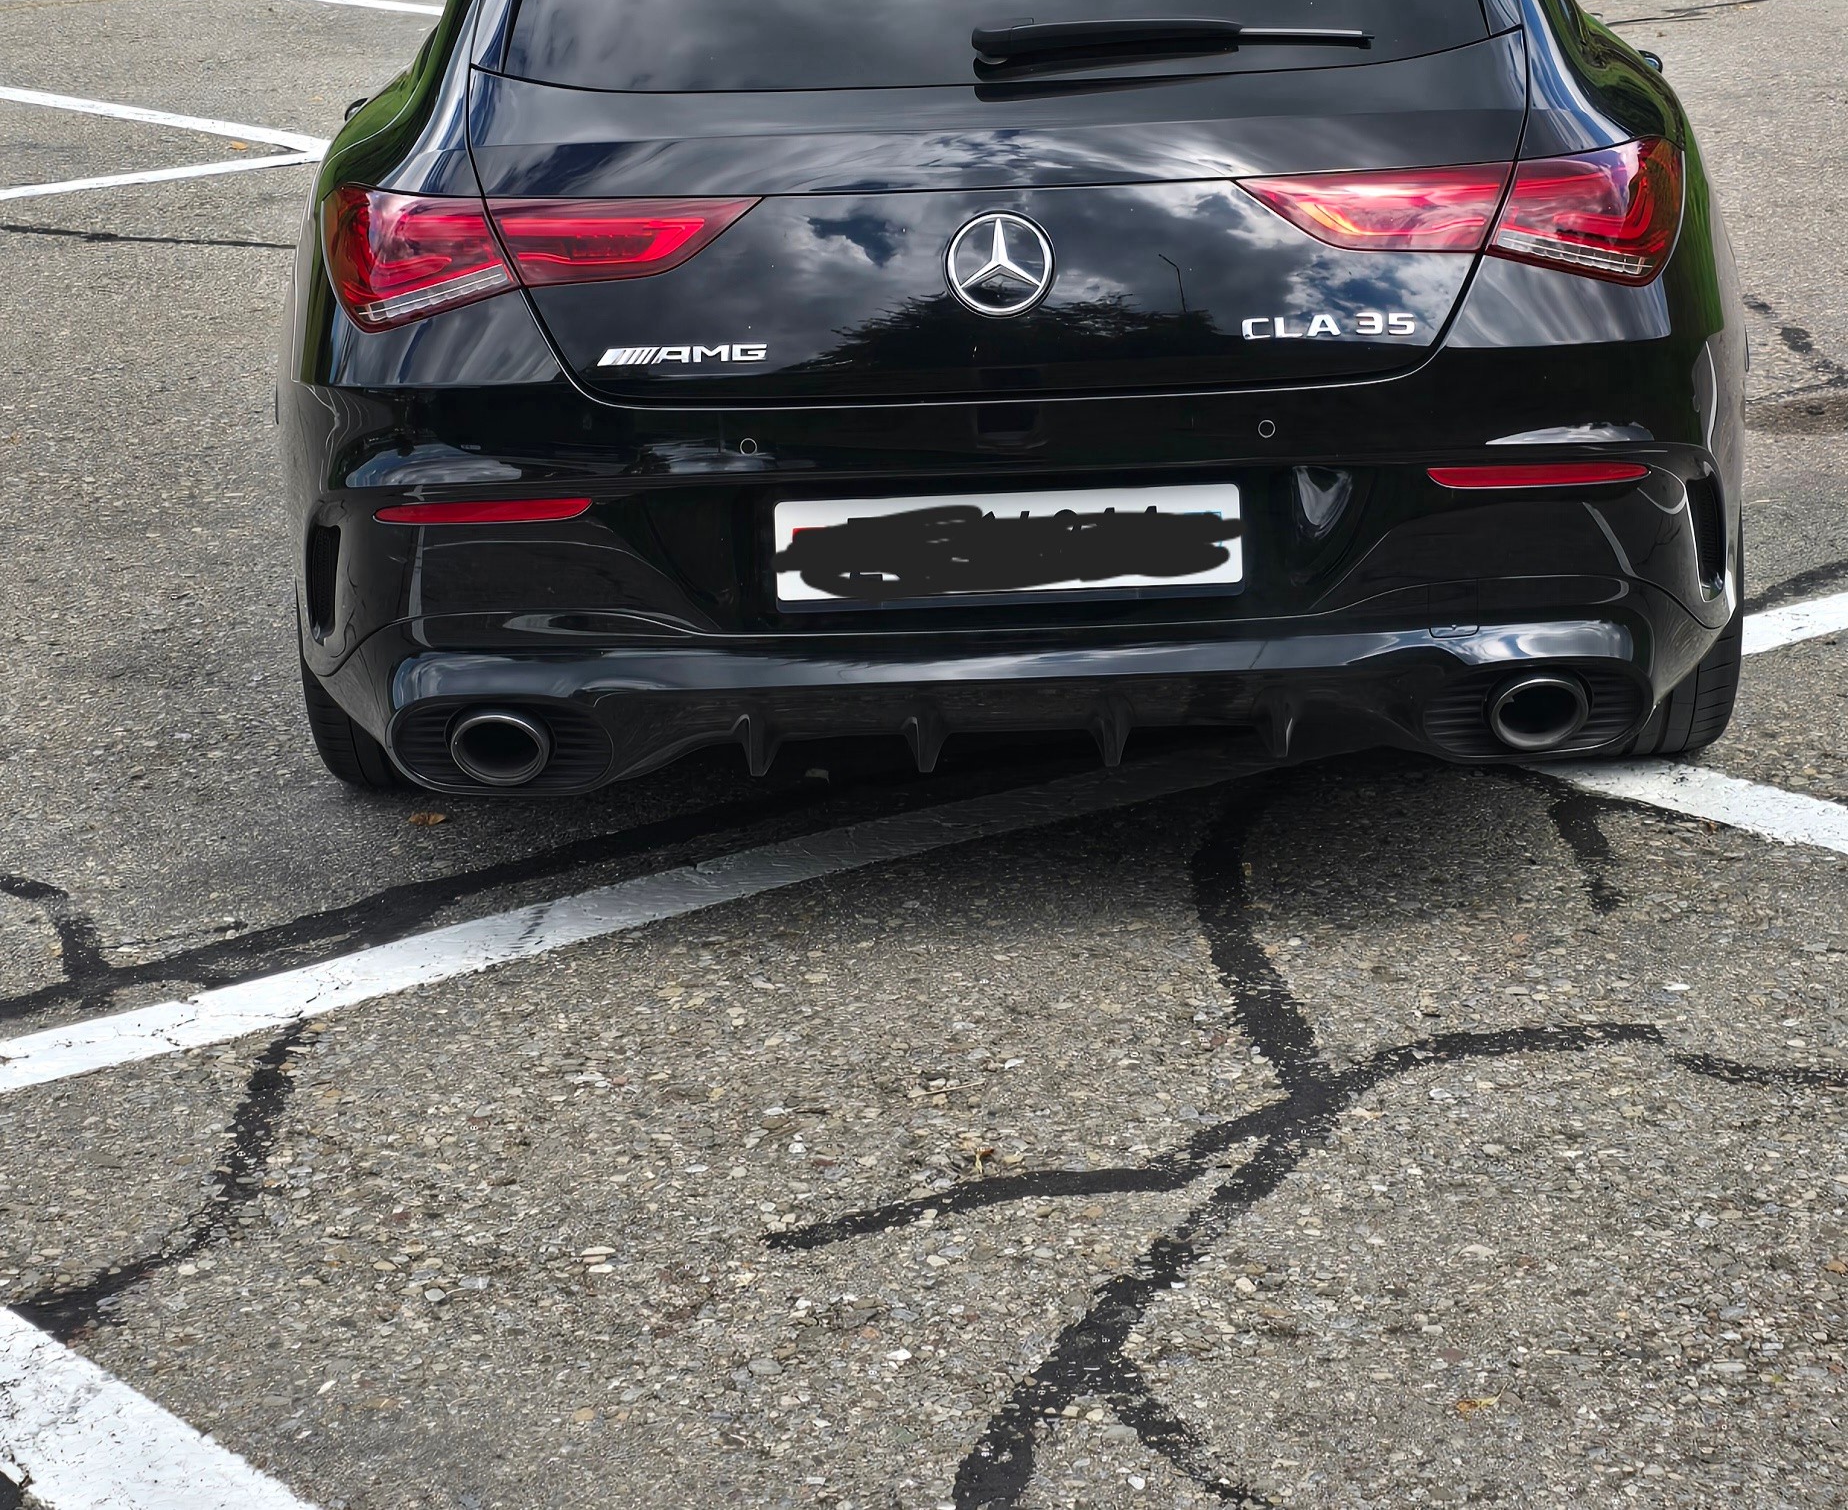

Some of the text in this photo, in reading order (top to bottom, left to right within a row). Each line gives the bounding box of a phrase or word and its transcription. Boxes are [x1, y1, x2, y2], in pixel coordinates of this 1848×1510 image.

[1241, 312, 1416, 340] CLA 35
[651, 343, 768, 365] AMG
